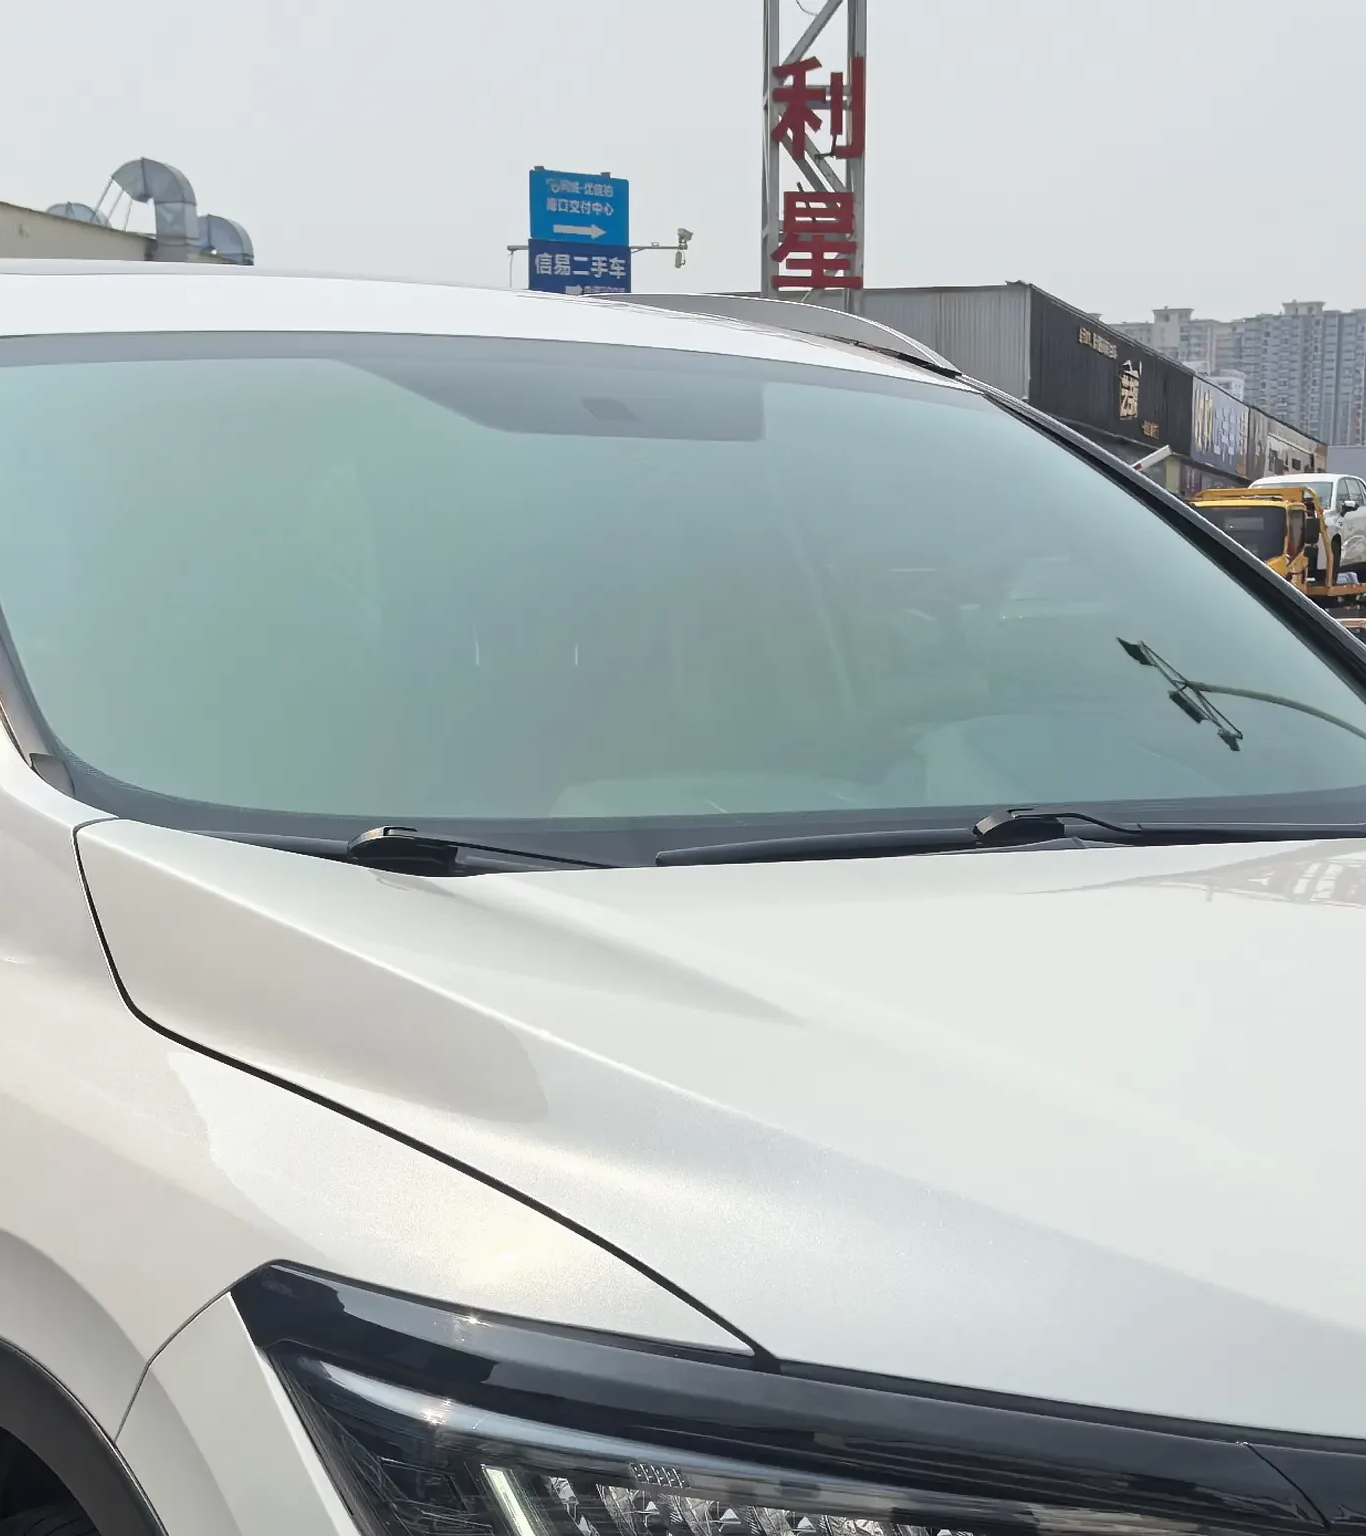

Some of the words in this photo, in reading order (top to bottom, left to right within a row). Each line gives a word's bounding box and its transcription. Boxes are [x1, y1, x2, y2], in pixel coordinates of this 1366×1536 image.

[535, 252, 626, 279] 信易二手车
